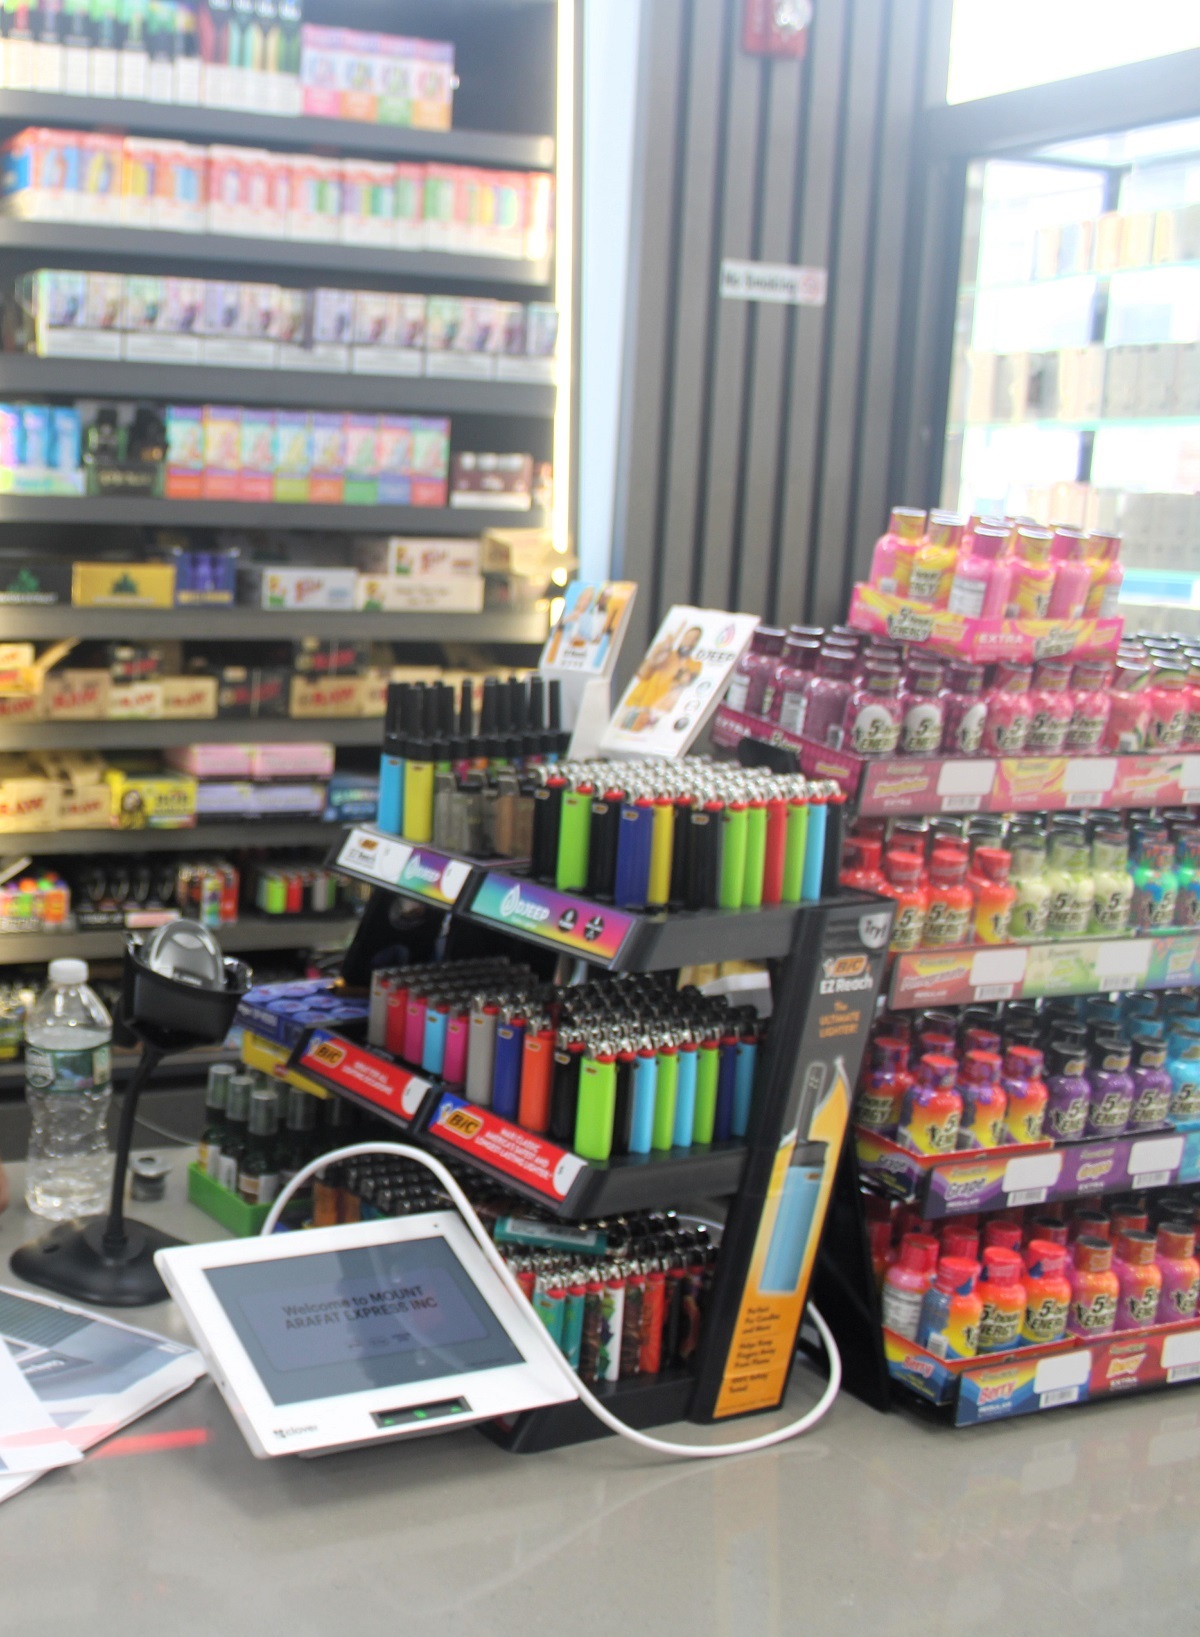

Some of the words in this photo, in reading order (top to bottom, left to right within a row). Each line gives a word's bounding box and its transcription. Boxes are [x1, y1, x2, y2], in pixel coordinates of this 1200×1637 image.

[978, 632, 1025, 645] EXTRA
[695, 649, 737, 664] DJEEP
[515, 899, 550, 922] DJEEP
[865, 919, 889, 940] Try!
[837, 960, 861, 973] BIC
[820, 979, 835, 994] EZ
[836, 974, 873, 992] Reach
[318, 1046, 340, 1064] BIC
[450, 1113, 478, 1134] BIC
[945, 1176, 986, 1200] Grape
[282, 1300, 350, 1318] Welcome
[352, 1294, 368, 1306] to
[368, 1285, 424, 1303] MOUNT
[285, 1312, 342, 1331] ARAFAT
[343, 1302, 408, 1321] EXPRESS
[411, 1297, 439, 1311] INC
[977, 1380, 1017, 1406] Berry
[285, 1425, 318, 1438] clover
